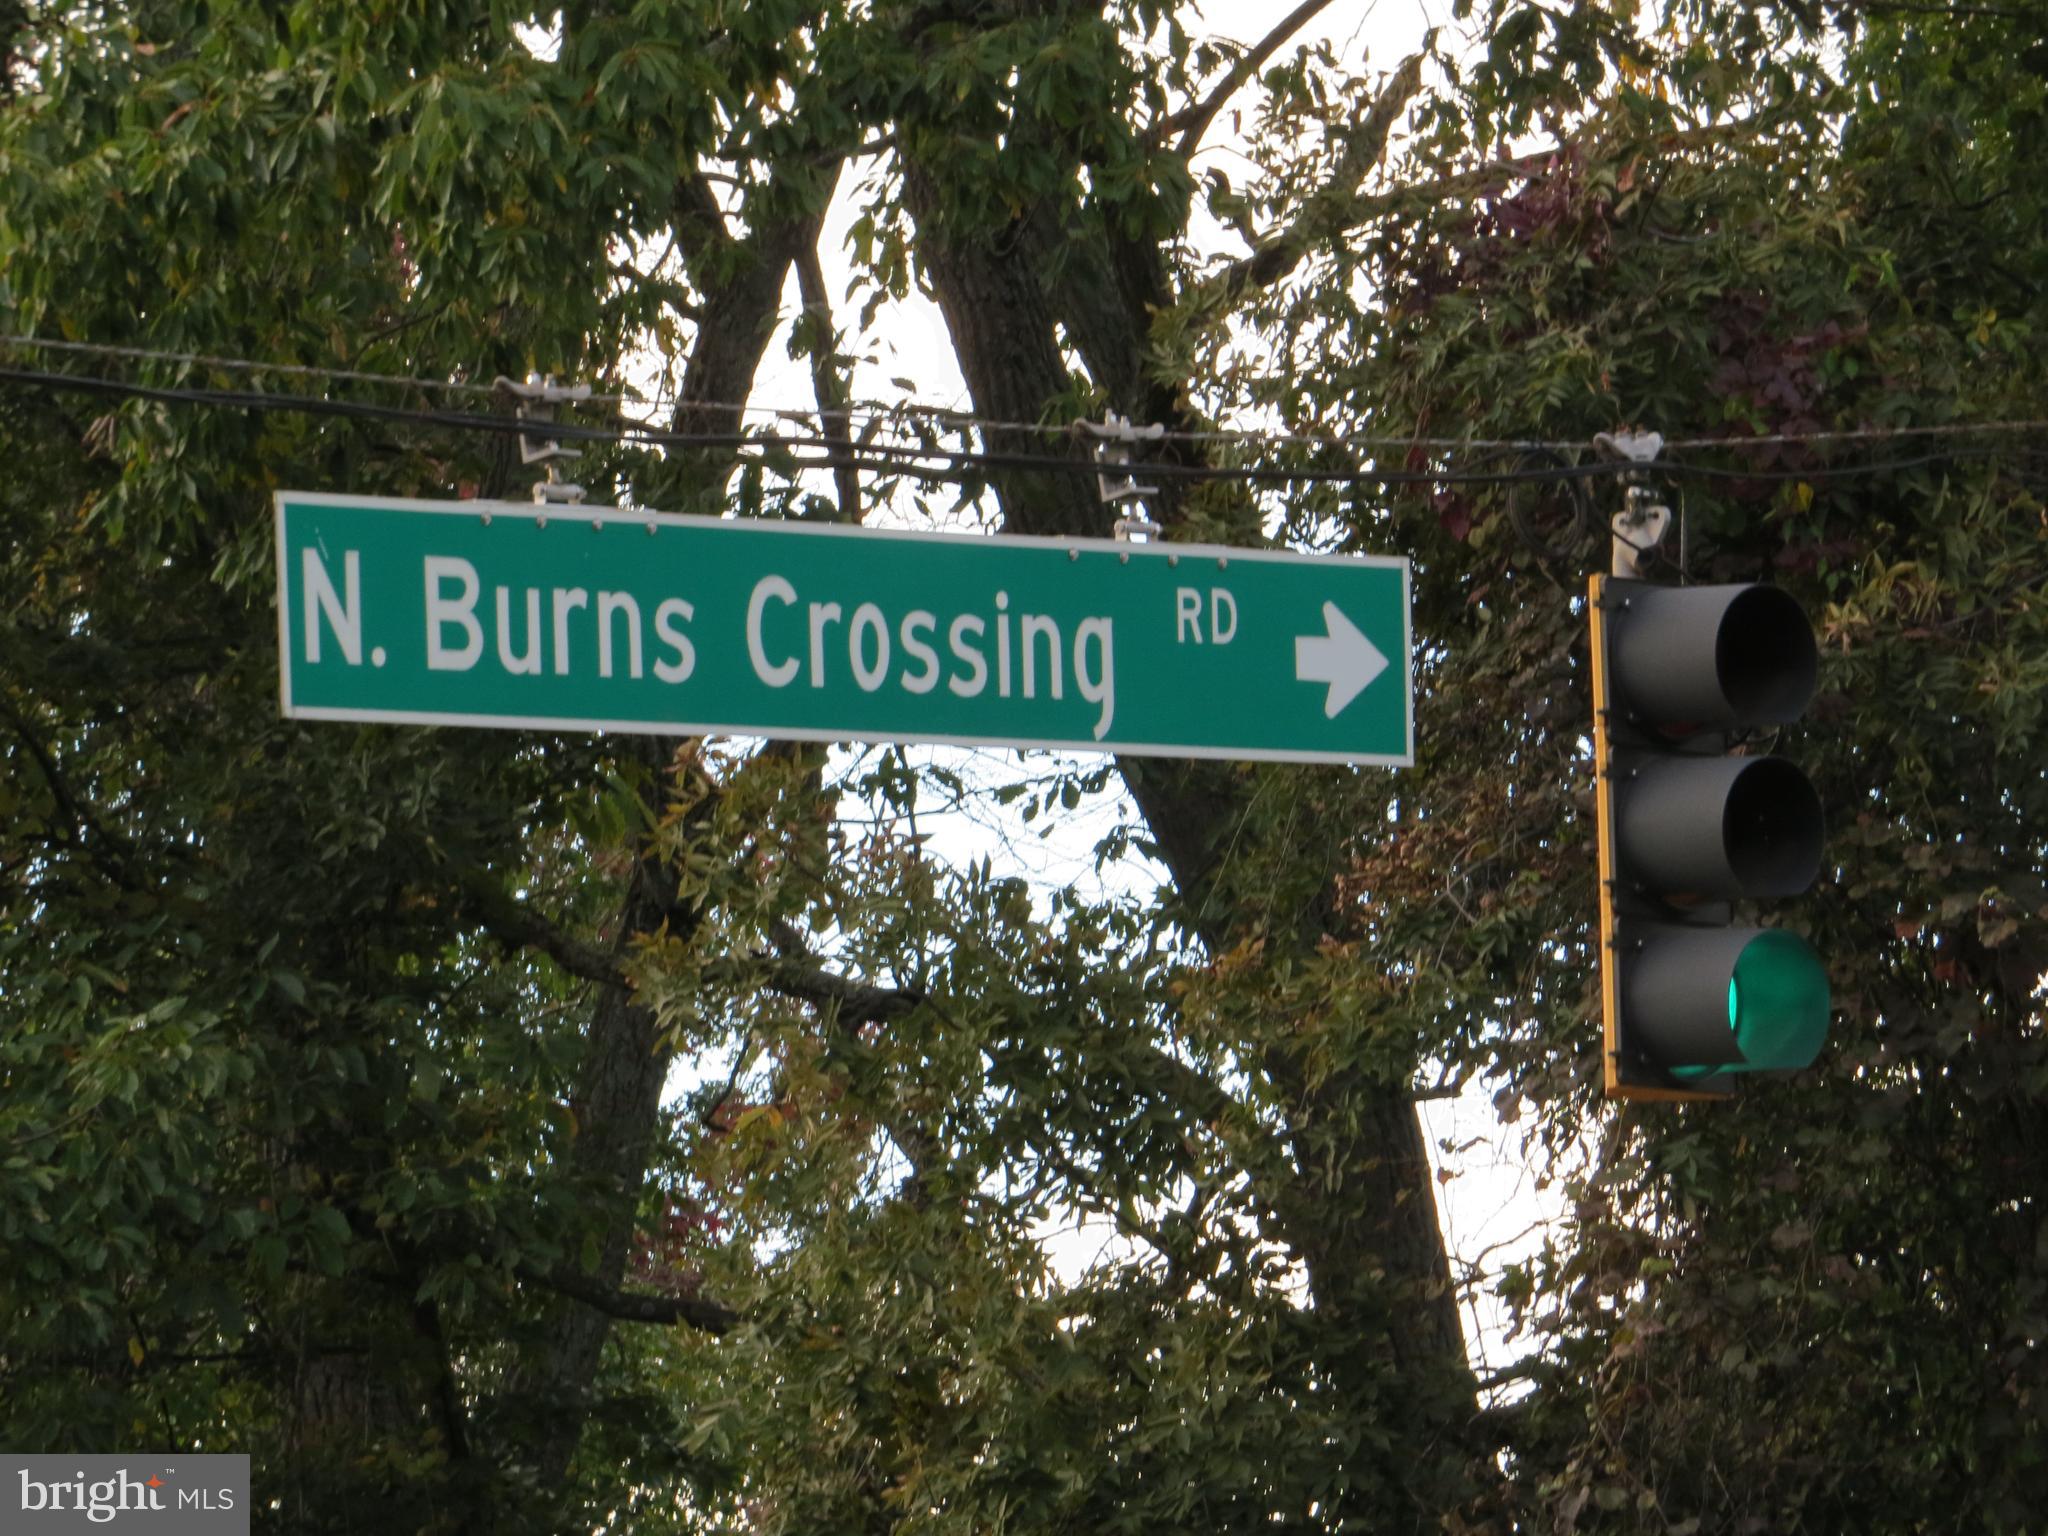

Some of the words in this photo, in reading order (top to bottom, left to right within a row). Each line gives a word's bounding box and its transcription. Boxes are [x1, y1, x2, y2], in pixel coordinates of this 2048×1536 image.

[301, 547, 387, 668] N.
[423, 555, 696, 685] Burns
[745, 574, 1116, 743] Crossing
[1176, 586, 1238, 645] RD
